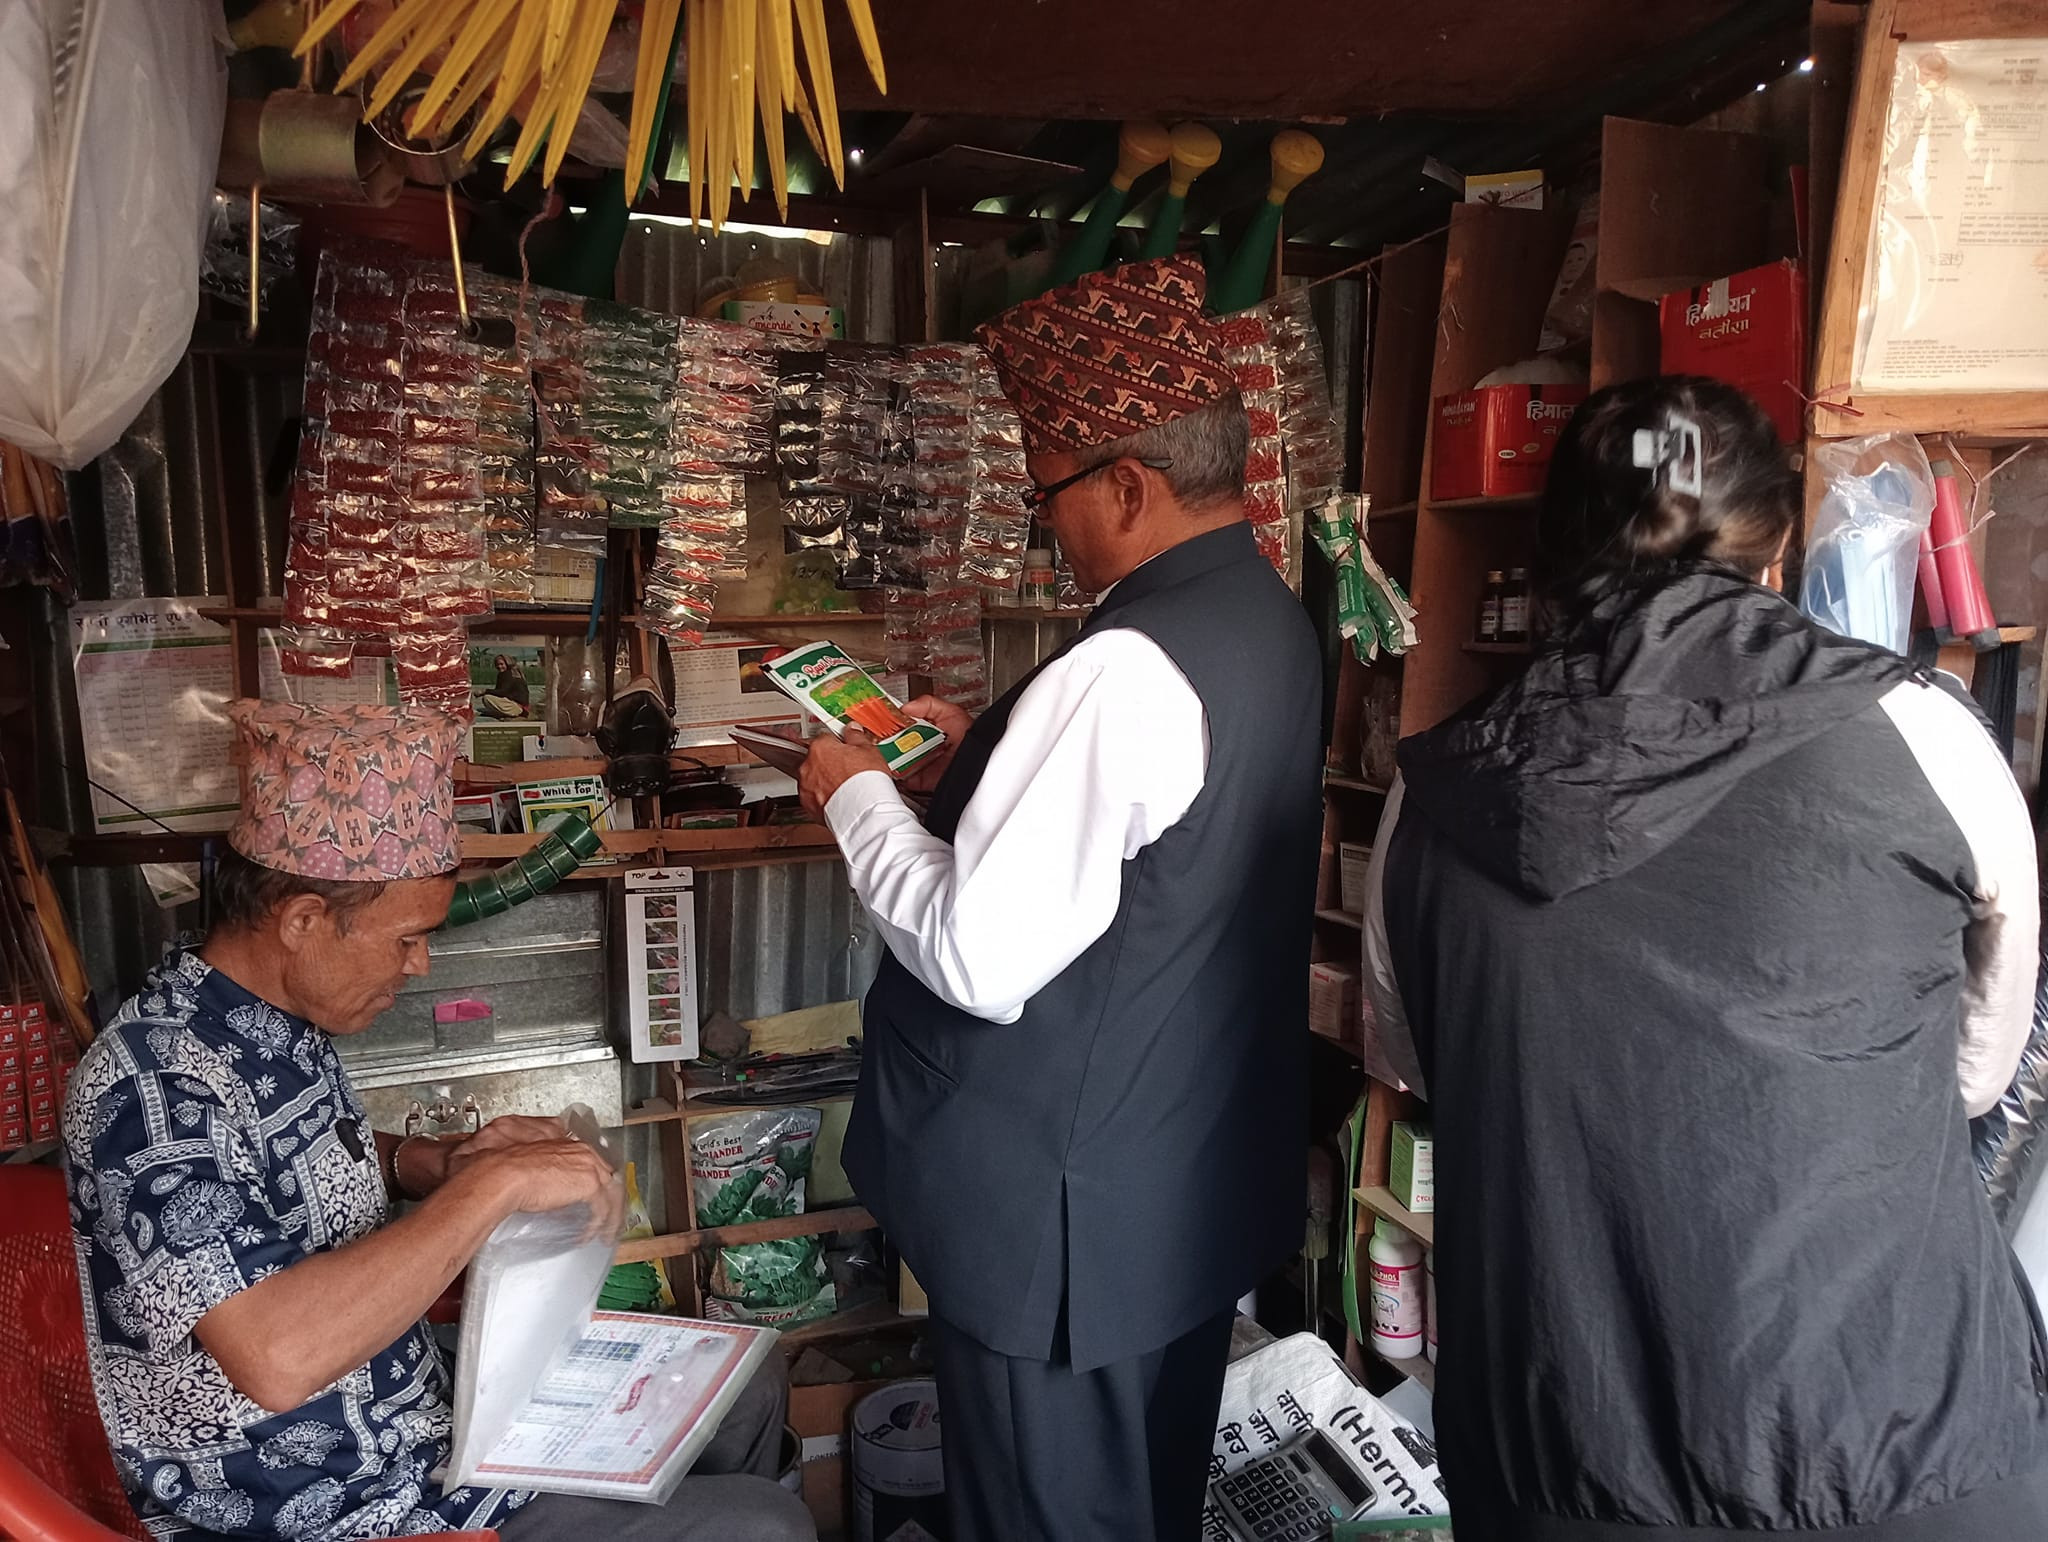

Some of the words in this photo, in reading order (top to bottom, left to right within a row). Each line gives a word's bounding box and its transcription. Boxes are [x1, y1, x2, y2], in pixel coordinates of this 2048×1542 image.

[542, 786, 571, 797] White
[574, 784, 592, 795] Top
[723, 1136, 741, 1146] Best
[754, 1311, 793, 1323] GREEN
